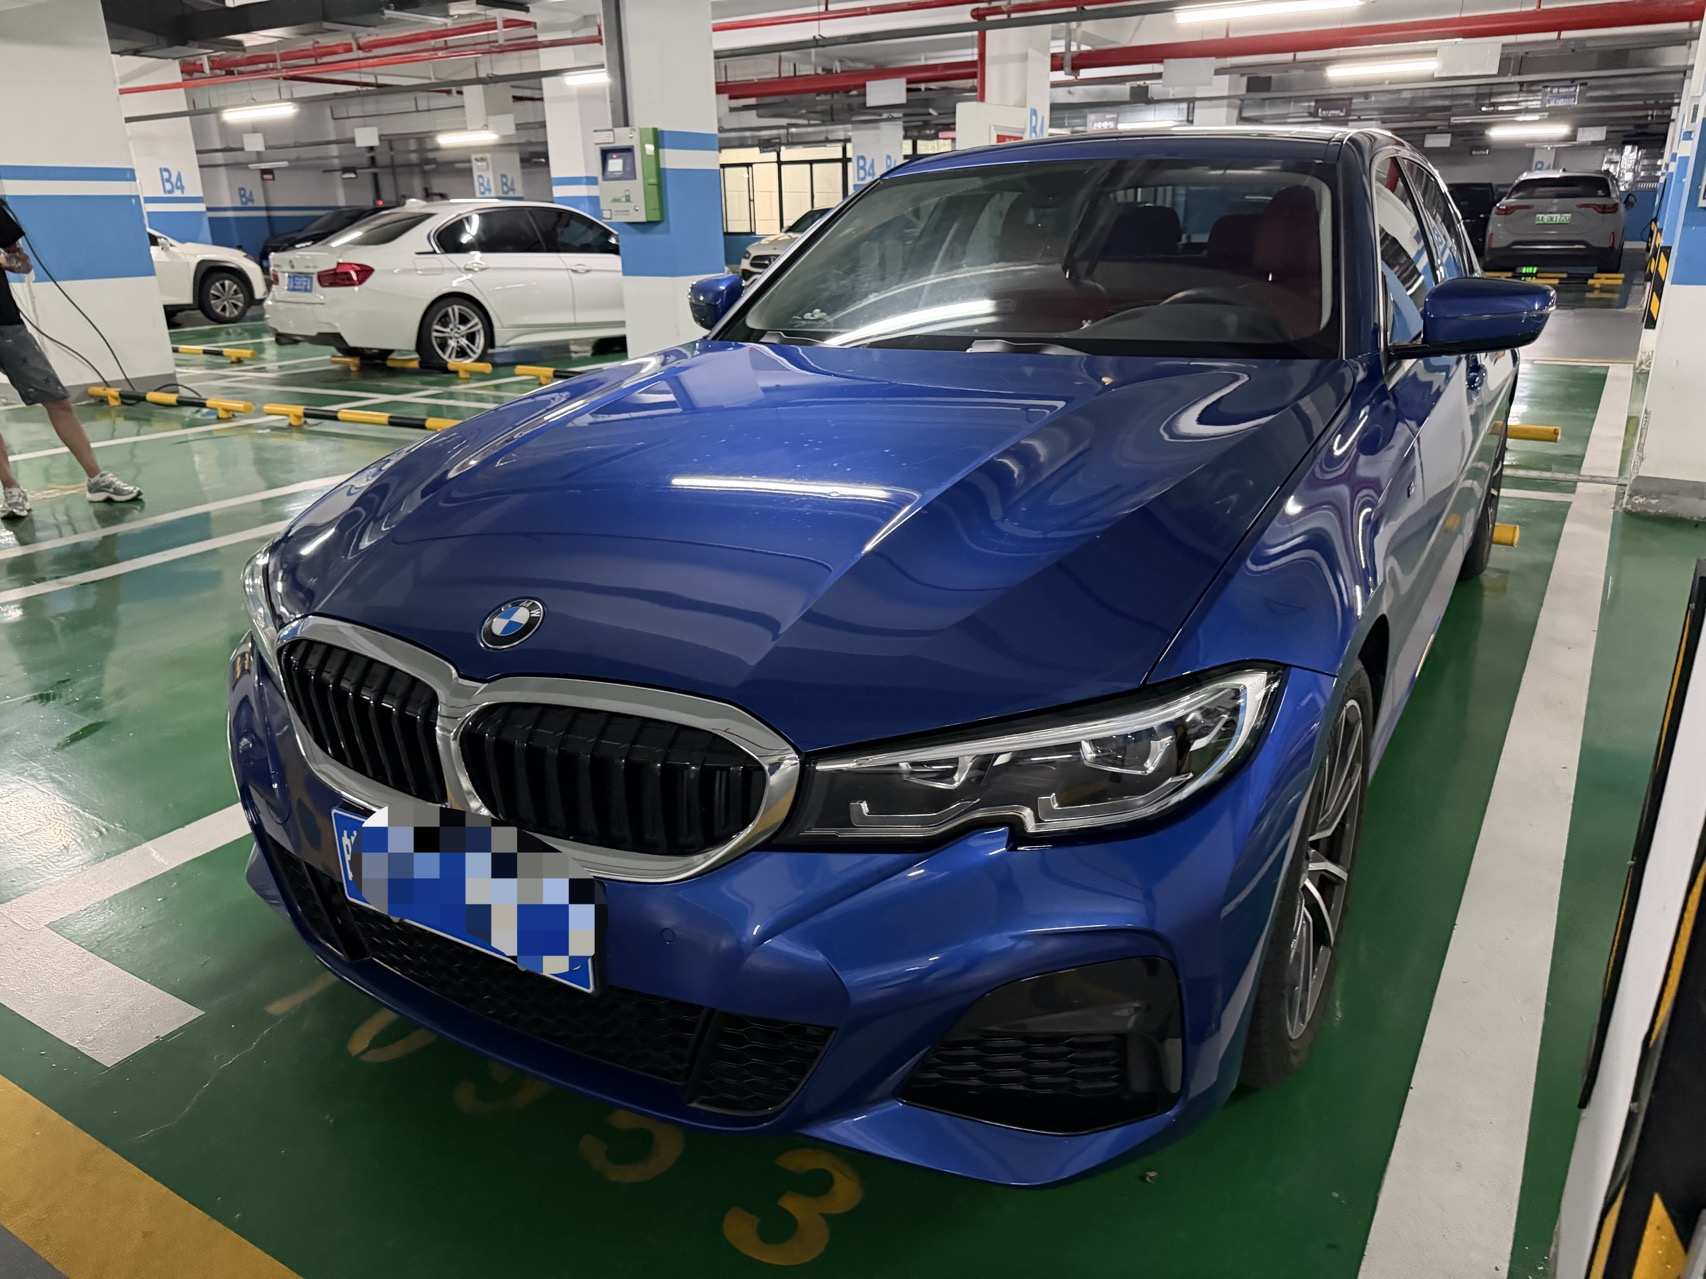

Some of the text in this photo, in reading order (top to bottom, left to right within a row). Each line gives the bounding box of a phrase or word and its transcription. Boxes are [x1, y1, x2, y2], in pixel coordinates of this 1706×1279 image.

[856, 155, 876, 182] B4
[159, 167, 185, 194] B4
[477, 174, 492, 195] B4
[500, 173, 515, 195] B4
[238, 186, 255, 205] B4
